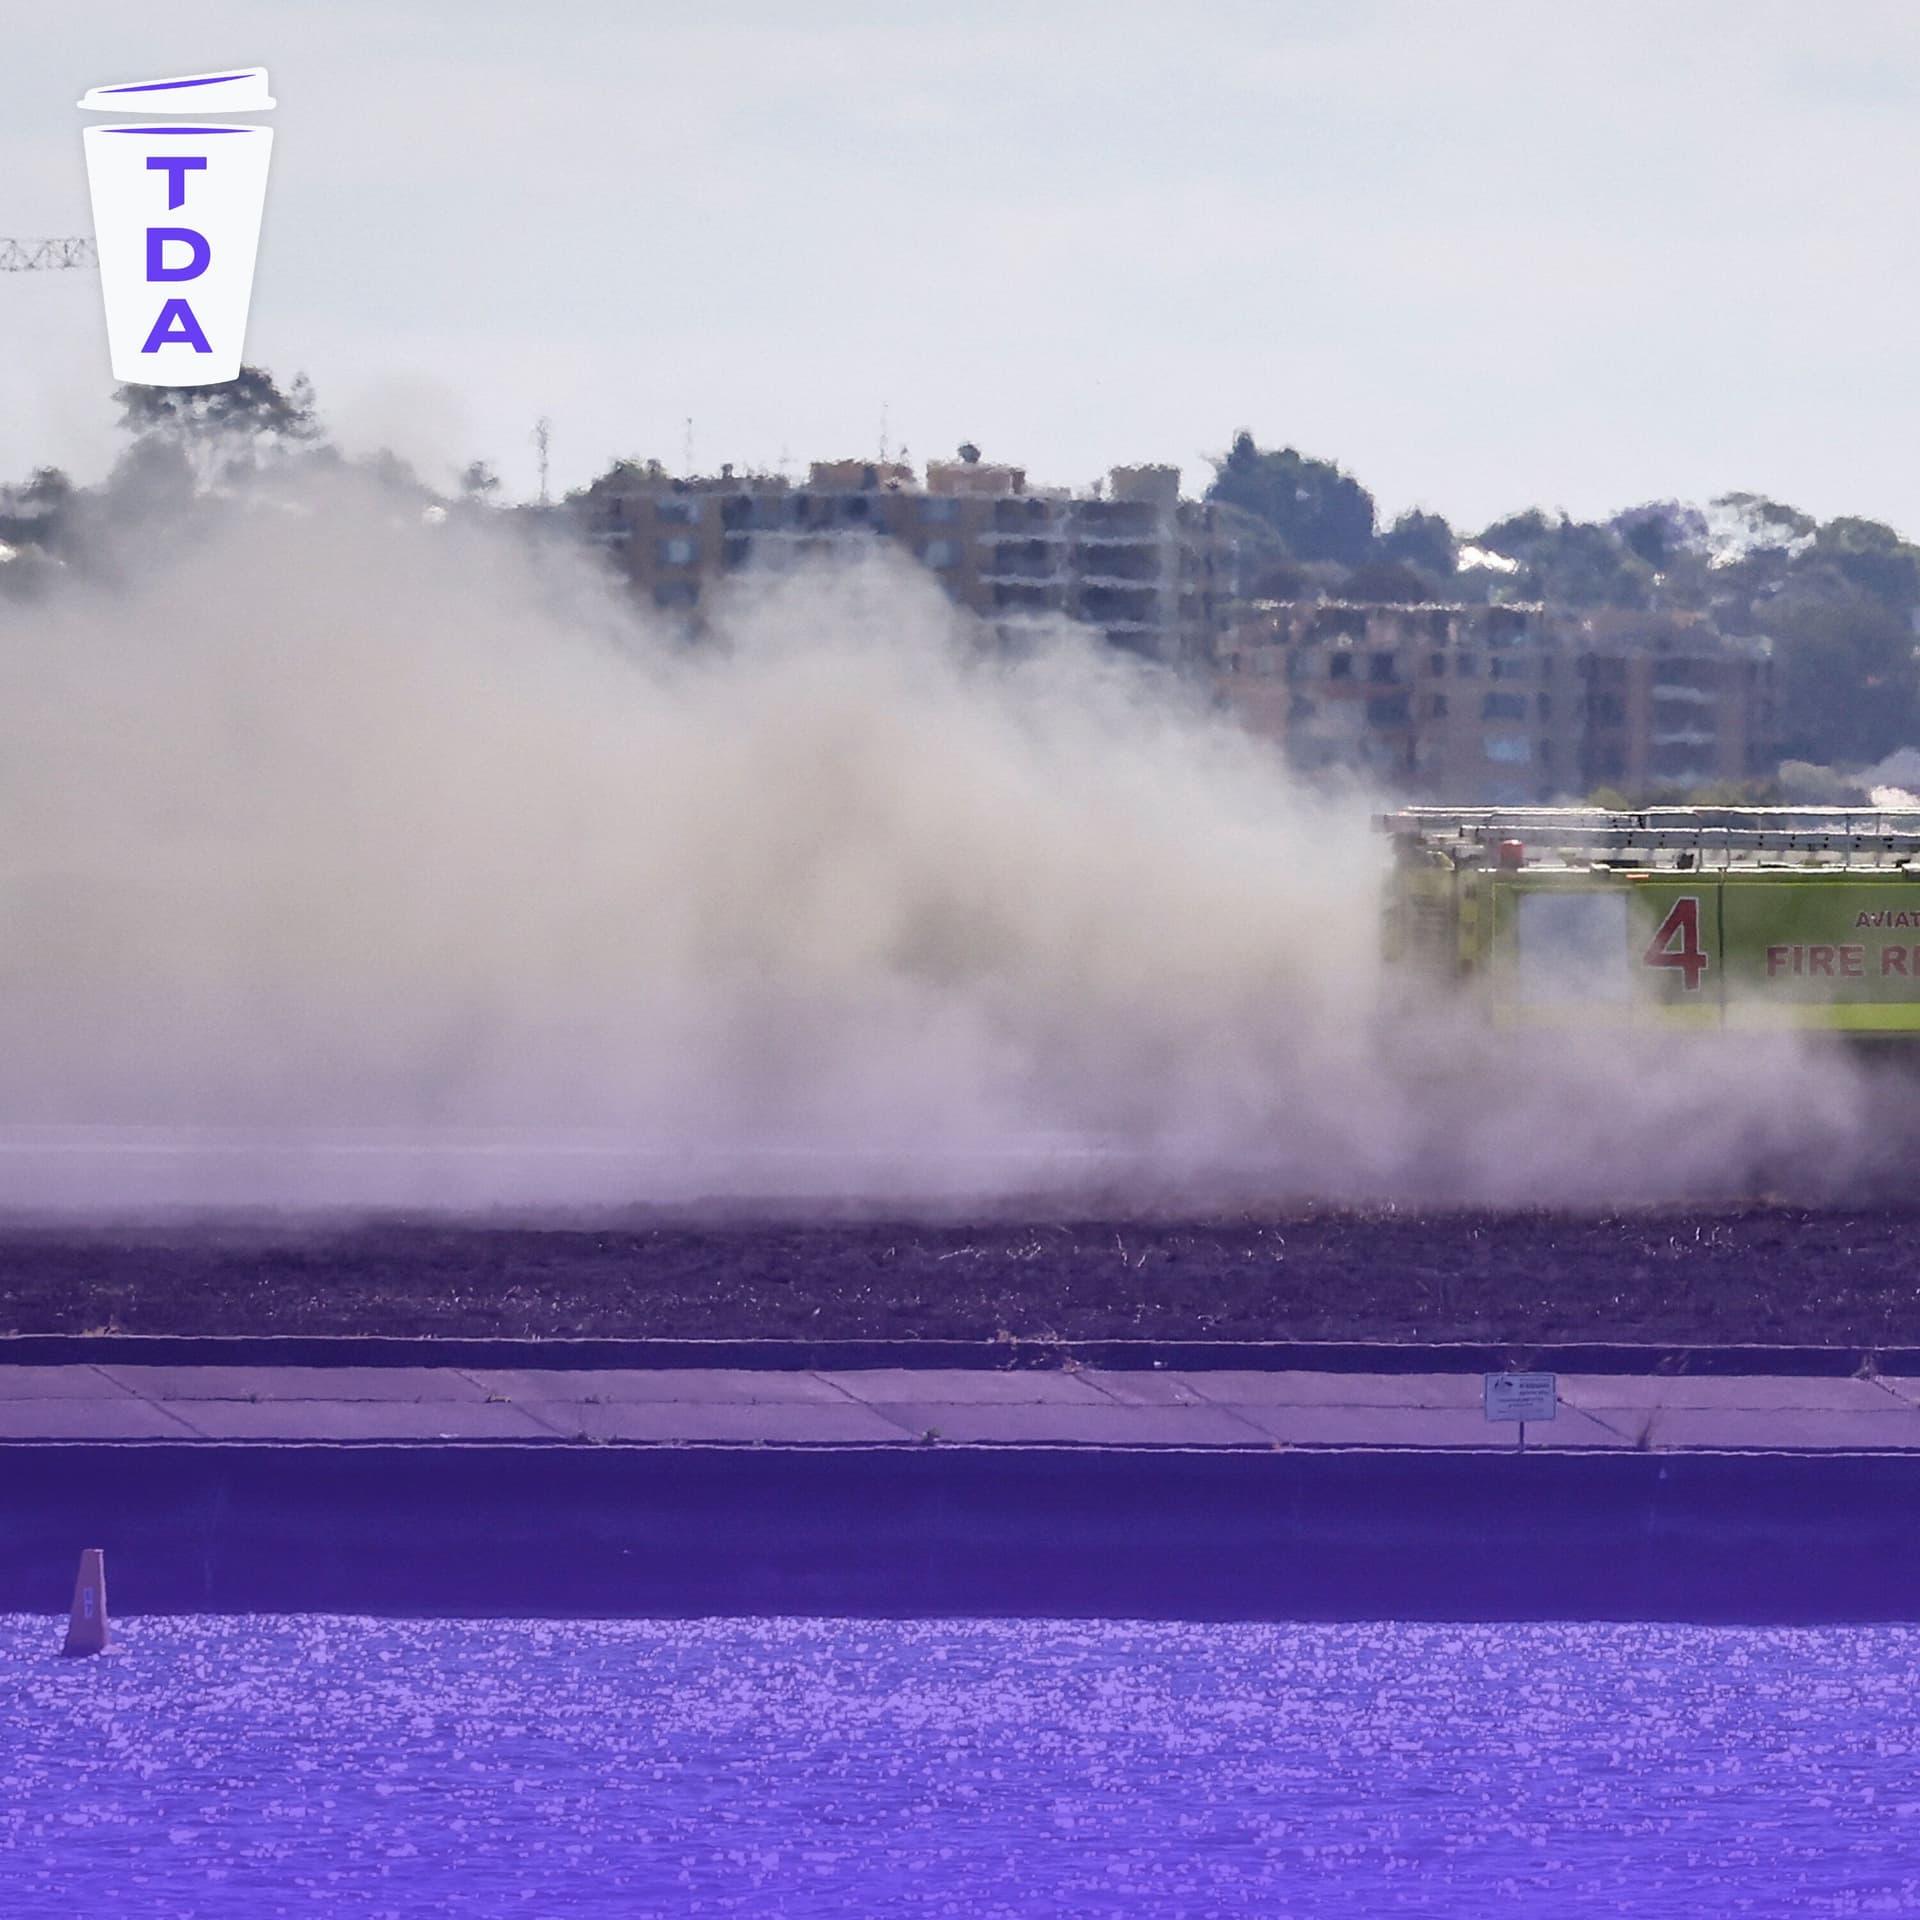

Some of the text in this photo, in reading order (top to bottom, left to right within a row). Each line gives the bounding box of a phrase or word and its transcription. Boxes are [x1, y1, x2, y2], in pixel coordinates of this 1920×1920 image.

[1855, 911, 1920, 928] AVIAT
[1643, 897, 1708, 992] 4
[1766, 945, 1865, 976] FIRE
